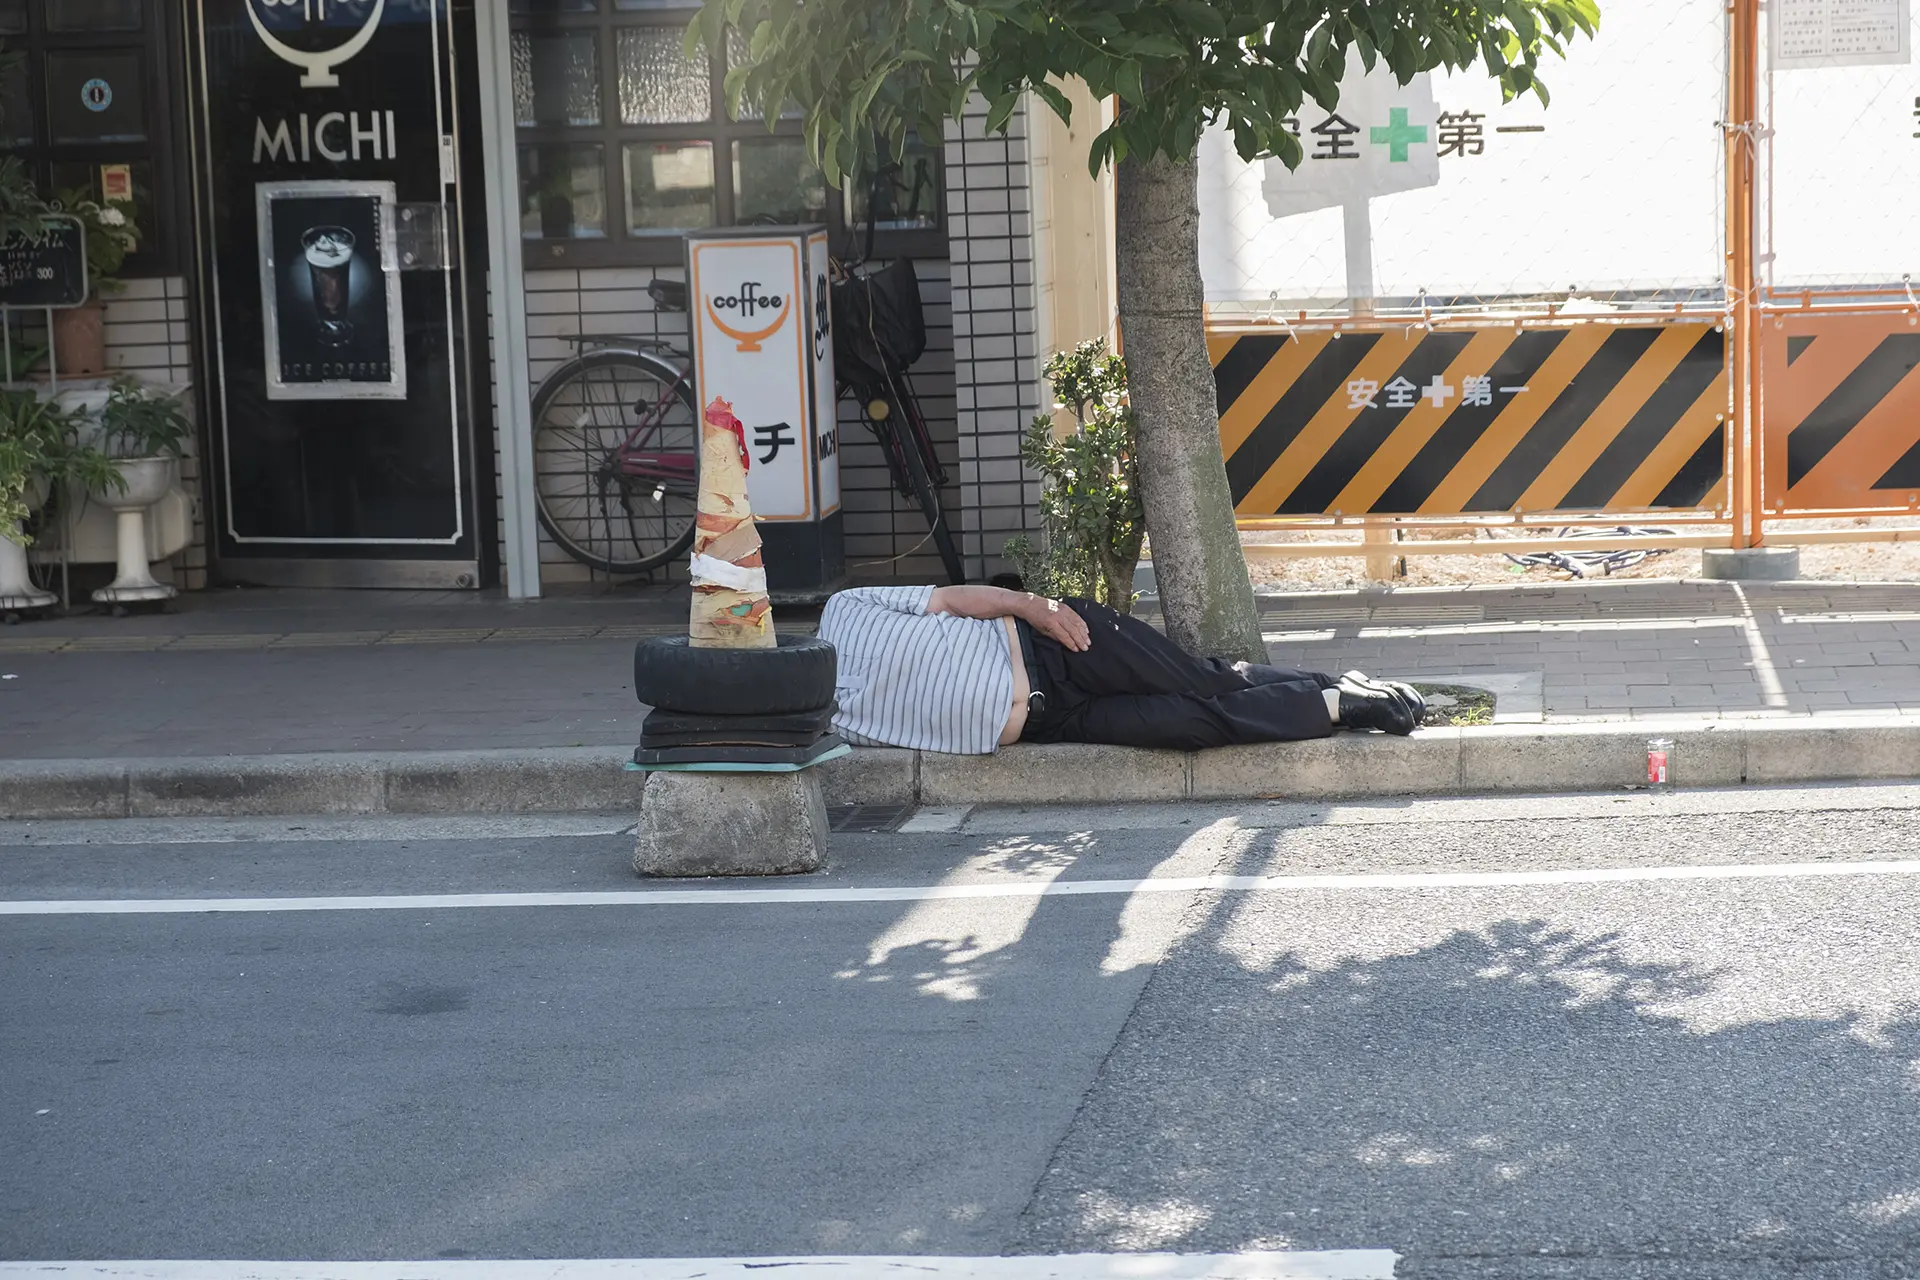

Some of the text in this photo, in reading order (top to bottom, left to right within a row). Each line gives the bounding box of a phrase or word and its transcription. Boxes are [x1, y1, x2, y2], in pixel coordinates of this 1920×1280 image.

[252, 110, 396, 163] MICHI
[713, 282, 782, 317] coffee
[283, 361, 390, 377] ICE COFFEE
